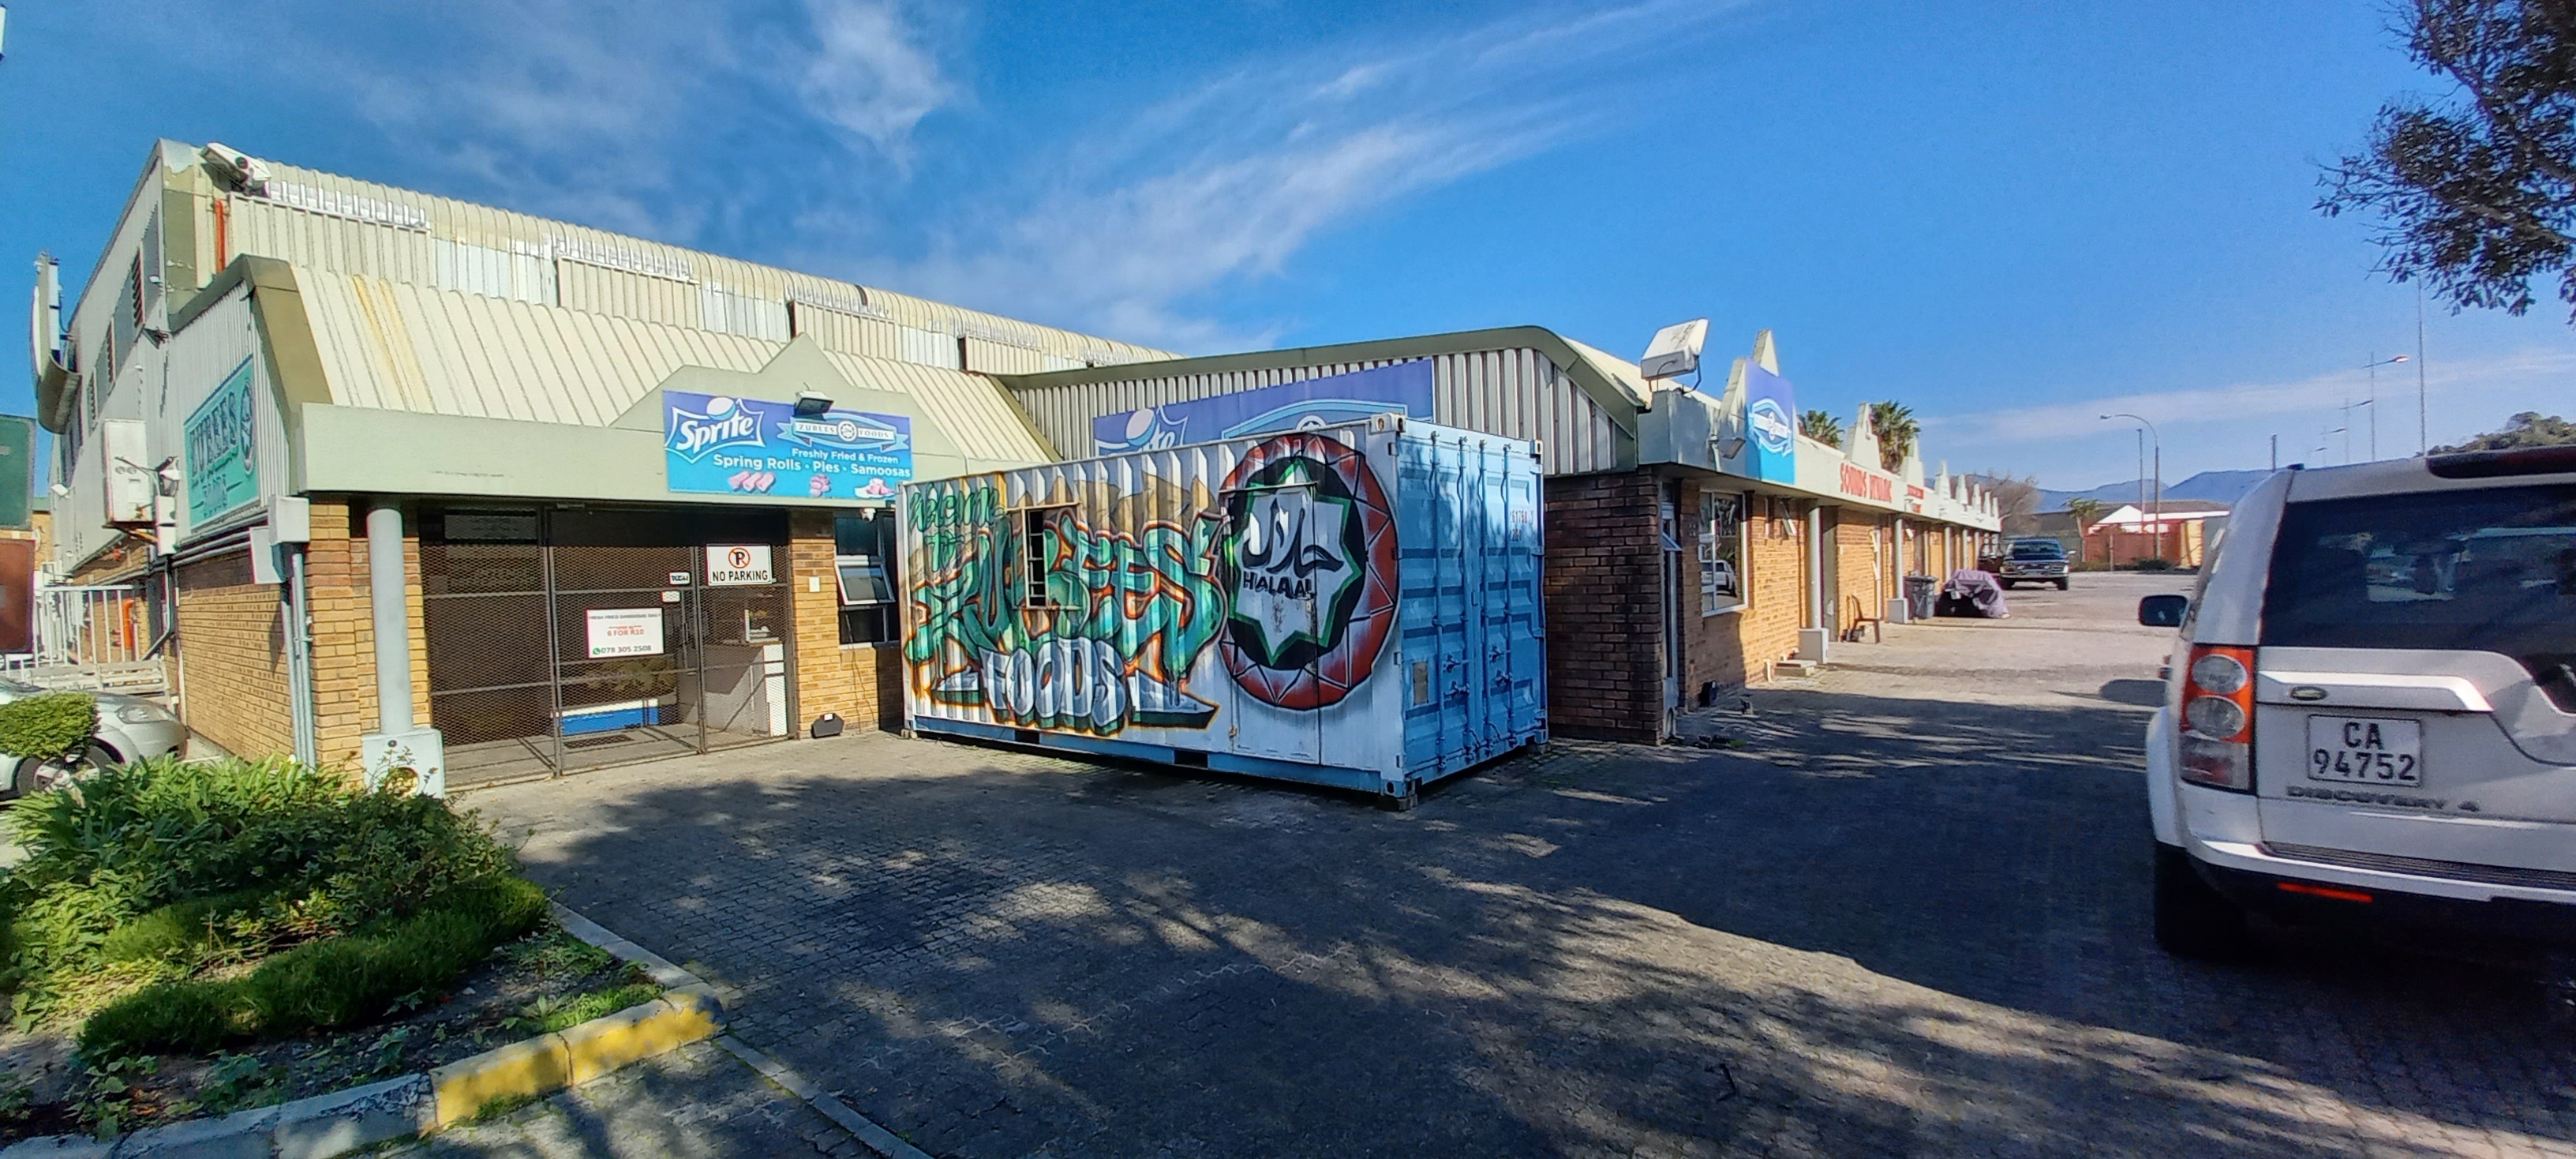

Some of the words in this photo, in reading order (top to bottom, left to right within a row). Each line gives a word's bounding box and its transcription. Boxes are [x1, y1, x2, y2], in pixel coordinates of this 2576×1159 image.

[676, 411, 754, 454] Sprite
[799, 423, 835, 433] ZUBEES
[859, 429, 889, 438] FOODS
[713, 454, 763, 471] Spring
[767, 458, 801, 471] Rolls
[813, 460, 841, 473] Pies
[851, 463, 912, 478] Samoosas
[792, 448, 829, 460] Freshly
[831, 451, 856, 461] Fried
[859, 452, 866, 461] &
[868, 453, 899, 464] Frozen
[713, 571, 725, 582] NO
[728, 570, 768, 582] PARKING
[978, 636, 1127, 728] FOODS
[2343, 722, 2383, 749] CA
[2313, 748, 2417, 782] 94752
